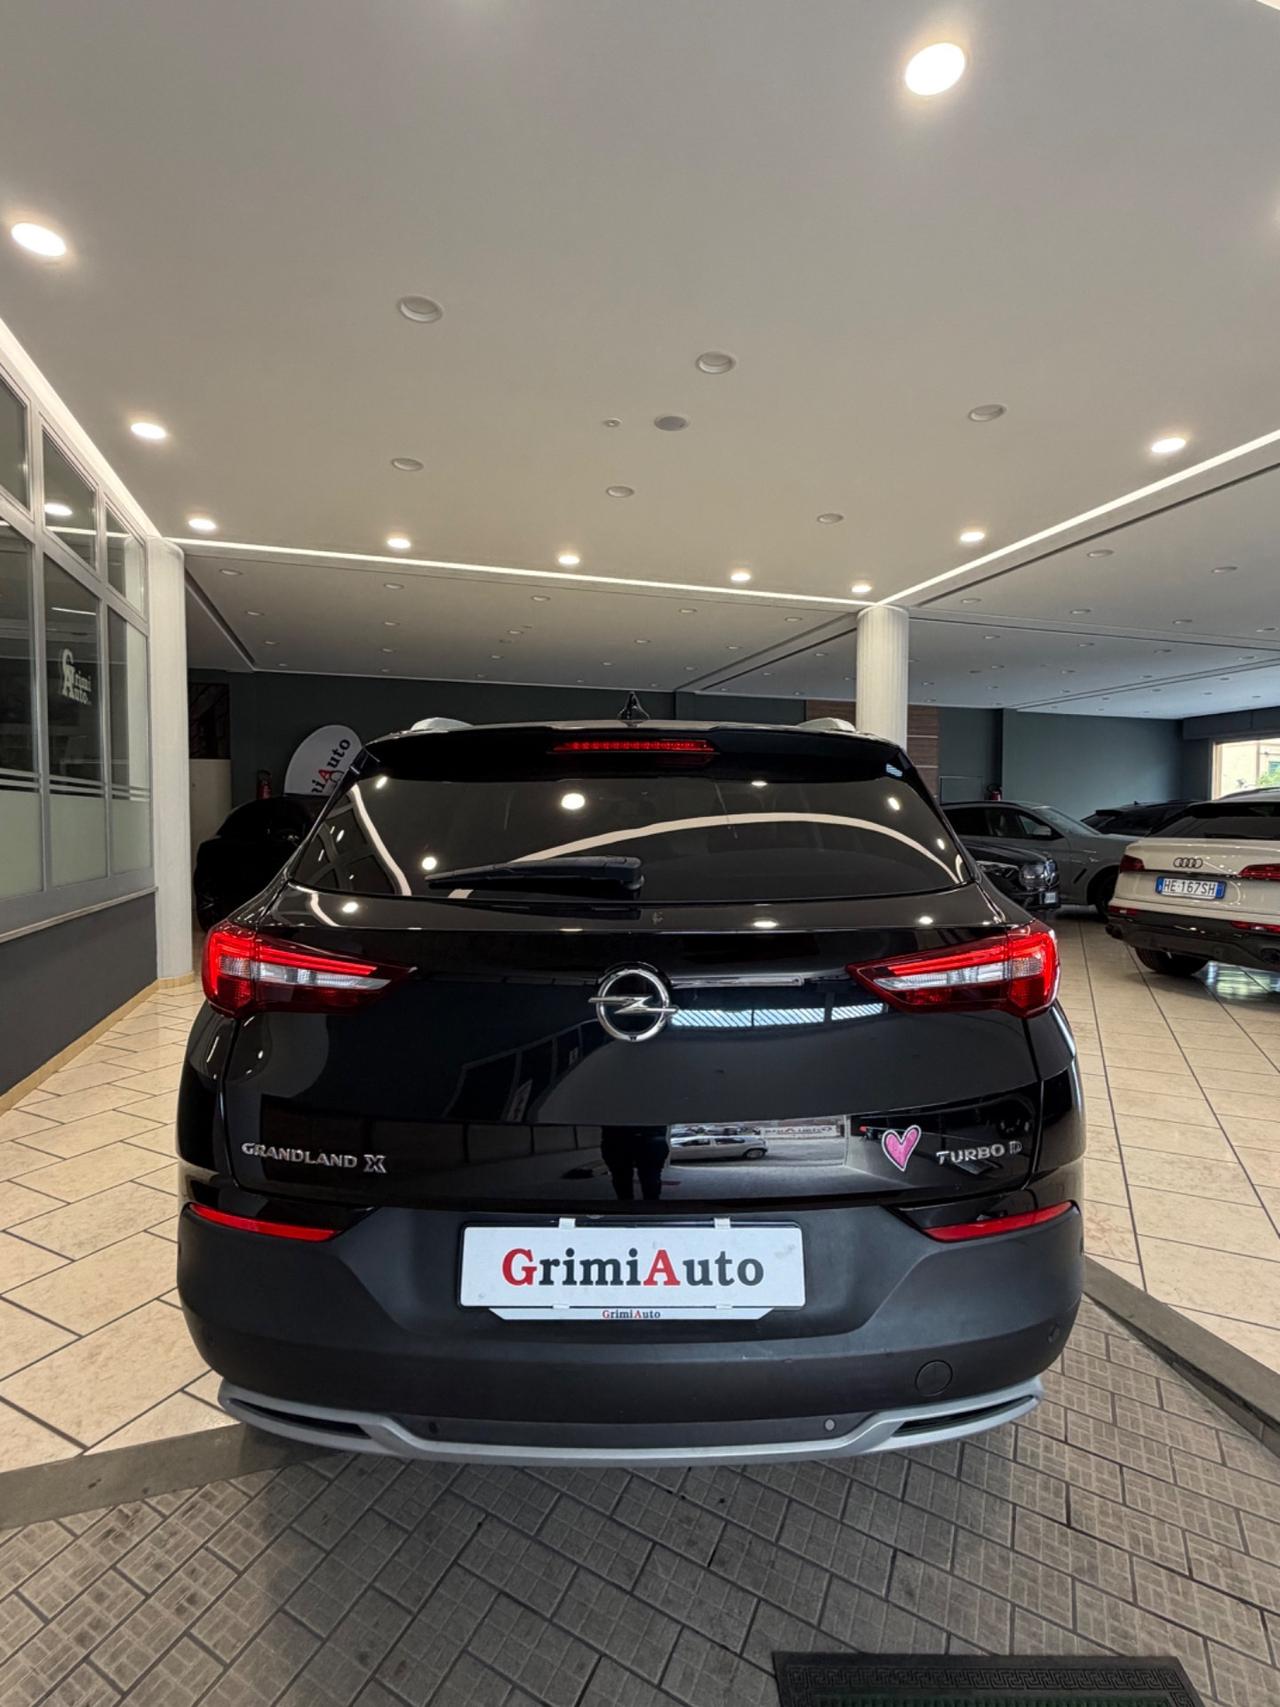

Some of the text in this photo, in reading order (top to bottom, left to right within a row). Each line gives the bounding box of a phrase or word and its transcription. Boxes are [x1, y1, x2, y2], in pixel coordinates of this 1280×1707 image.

[241, 1142, 387, 1173] GRANDLAND X
[936, 1140, 1023, 1165] TURBO D
[501, 1247, 765, 1287] GrimiAuto
[602, 1308, 661, 1320] GrimiAuto
